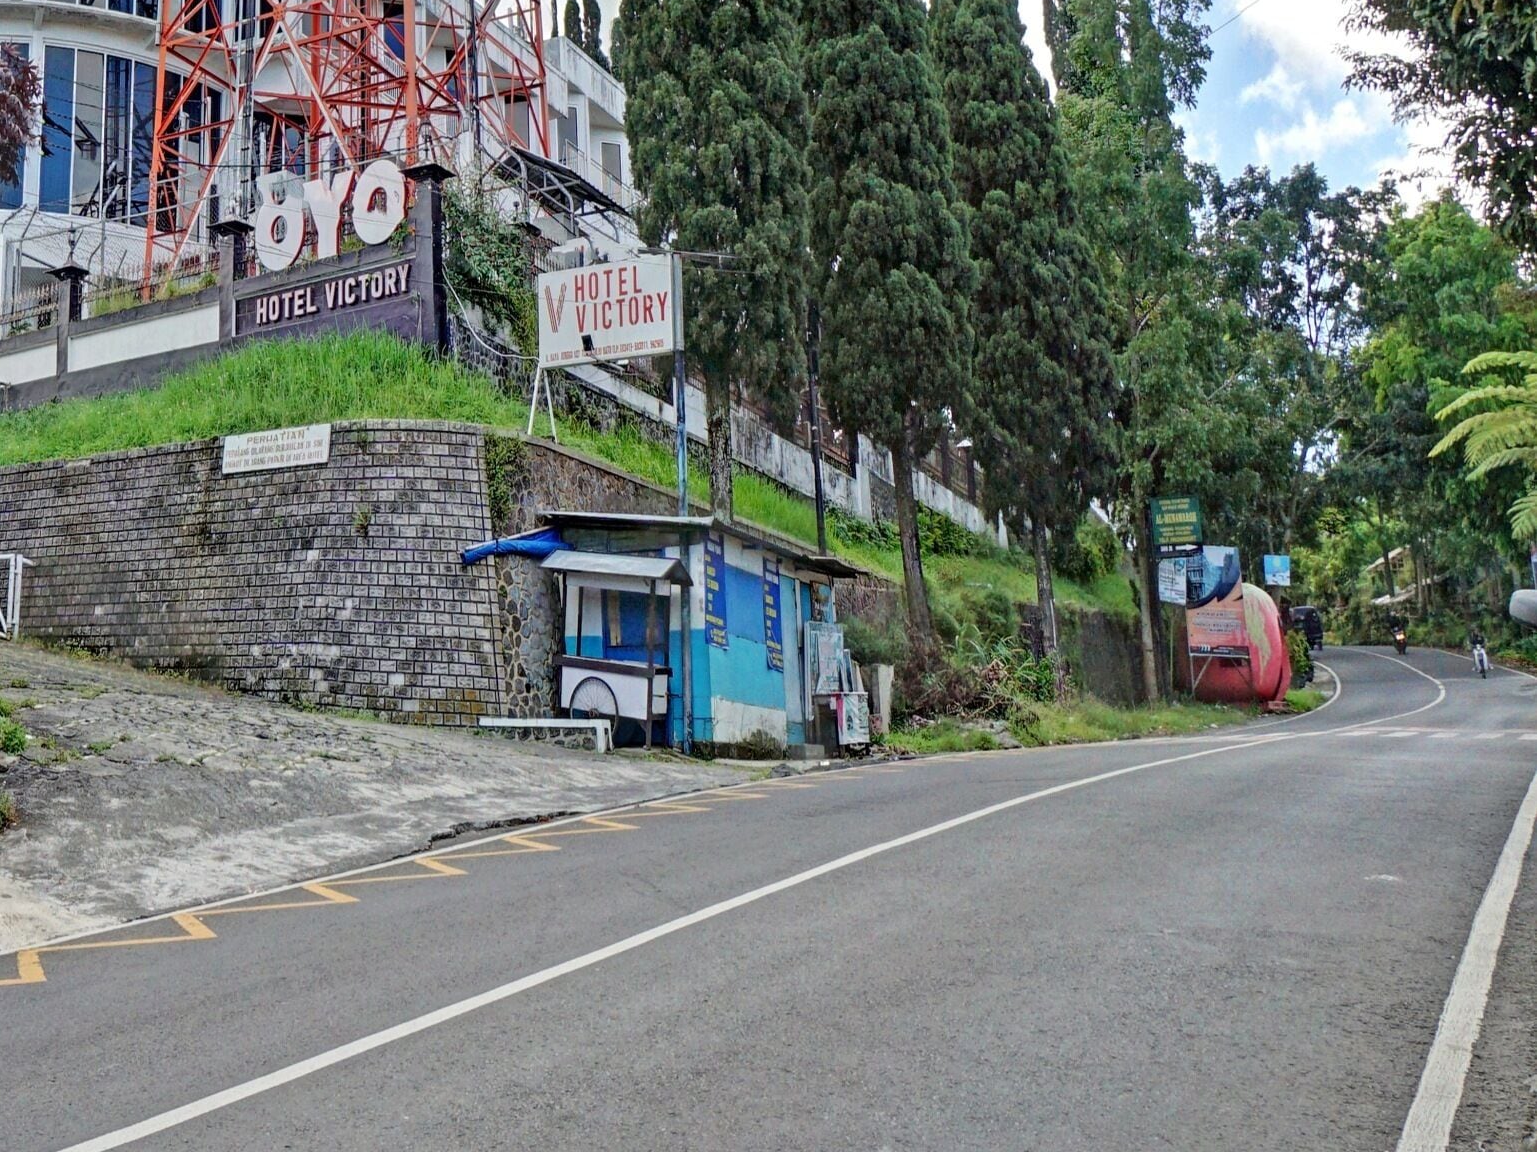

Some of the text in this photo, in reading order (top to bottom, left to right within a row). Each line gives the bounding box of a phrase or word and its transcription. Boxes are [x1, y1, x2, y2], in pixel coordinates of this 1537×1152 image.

[256, 264, 412, 325] HOTEL VICTORY
[574, 265, 642, 303] HOTEL
[576, 291, 668, 333] VICTORY
